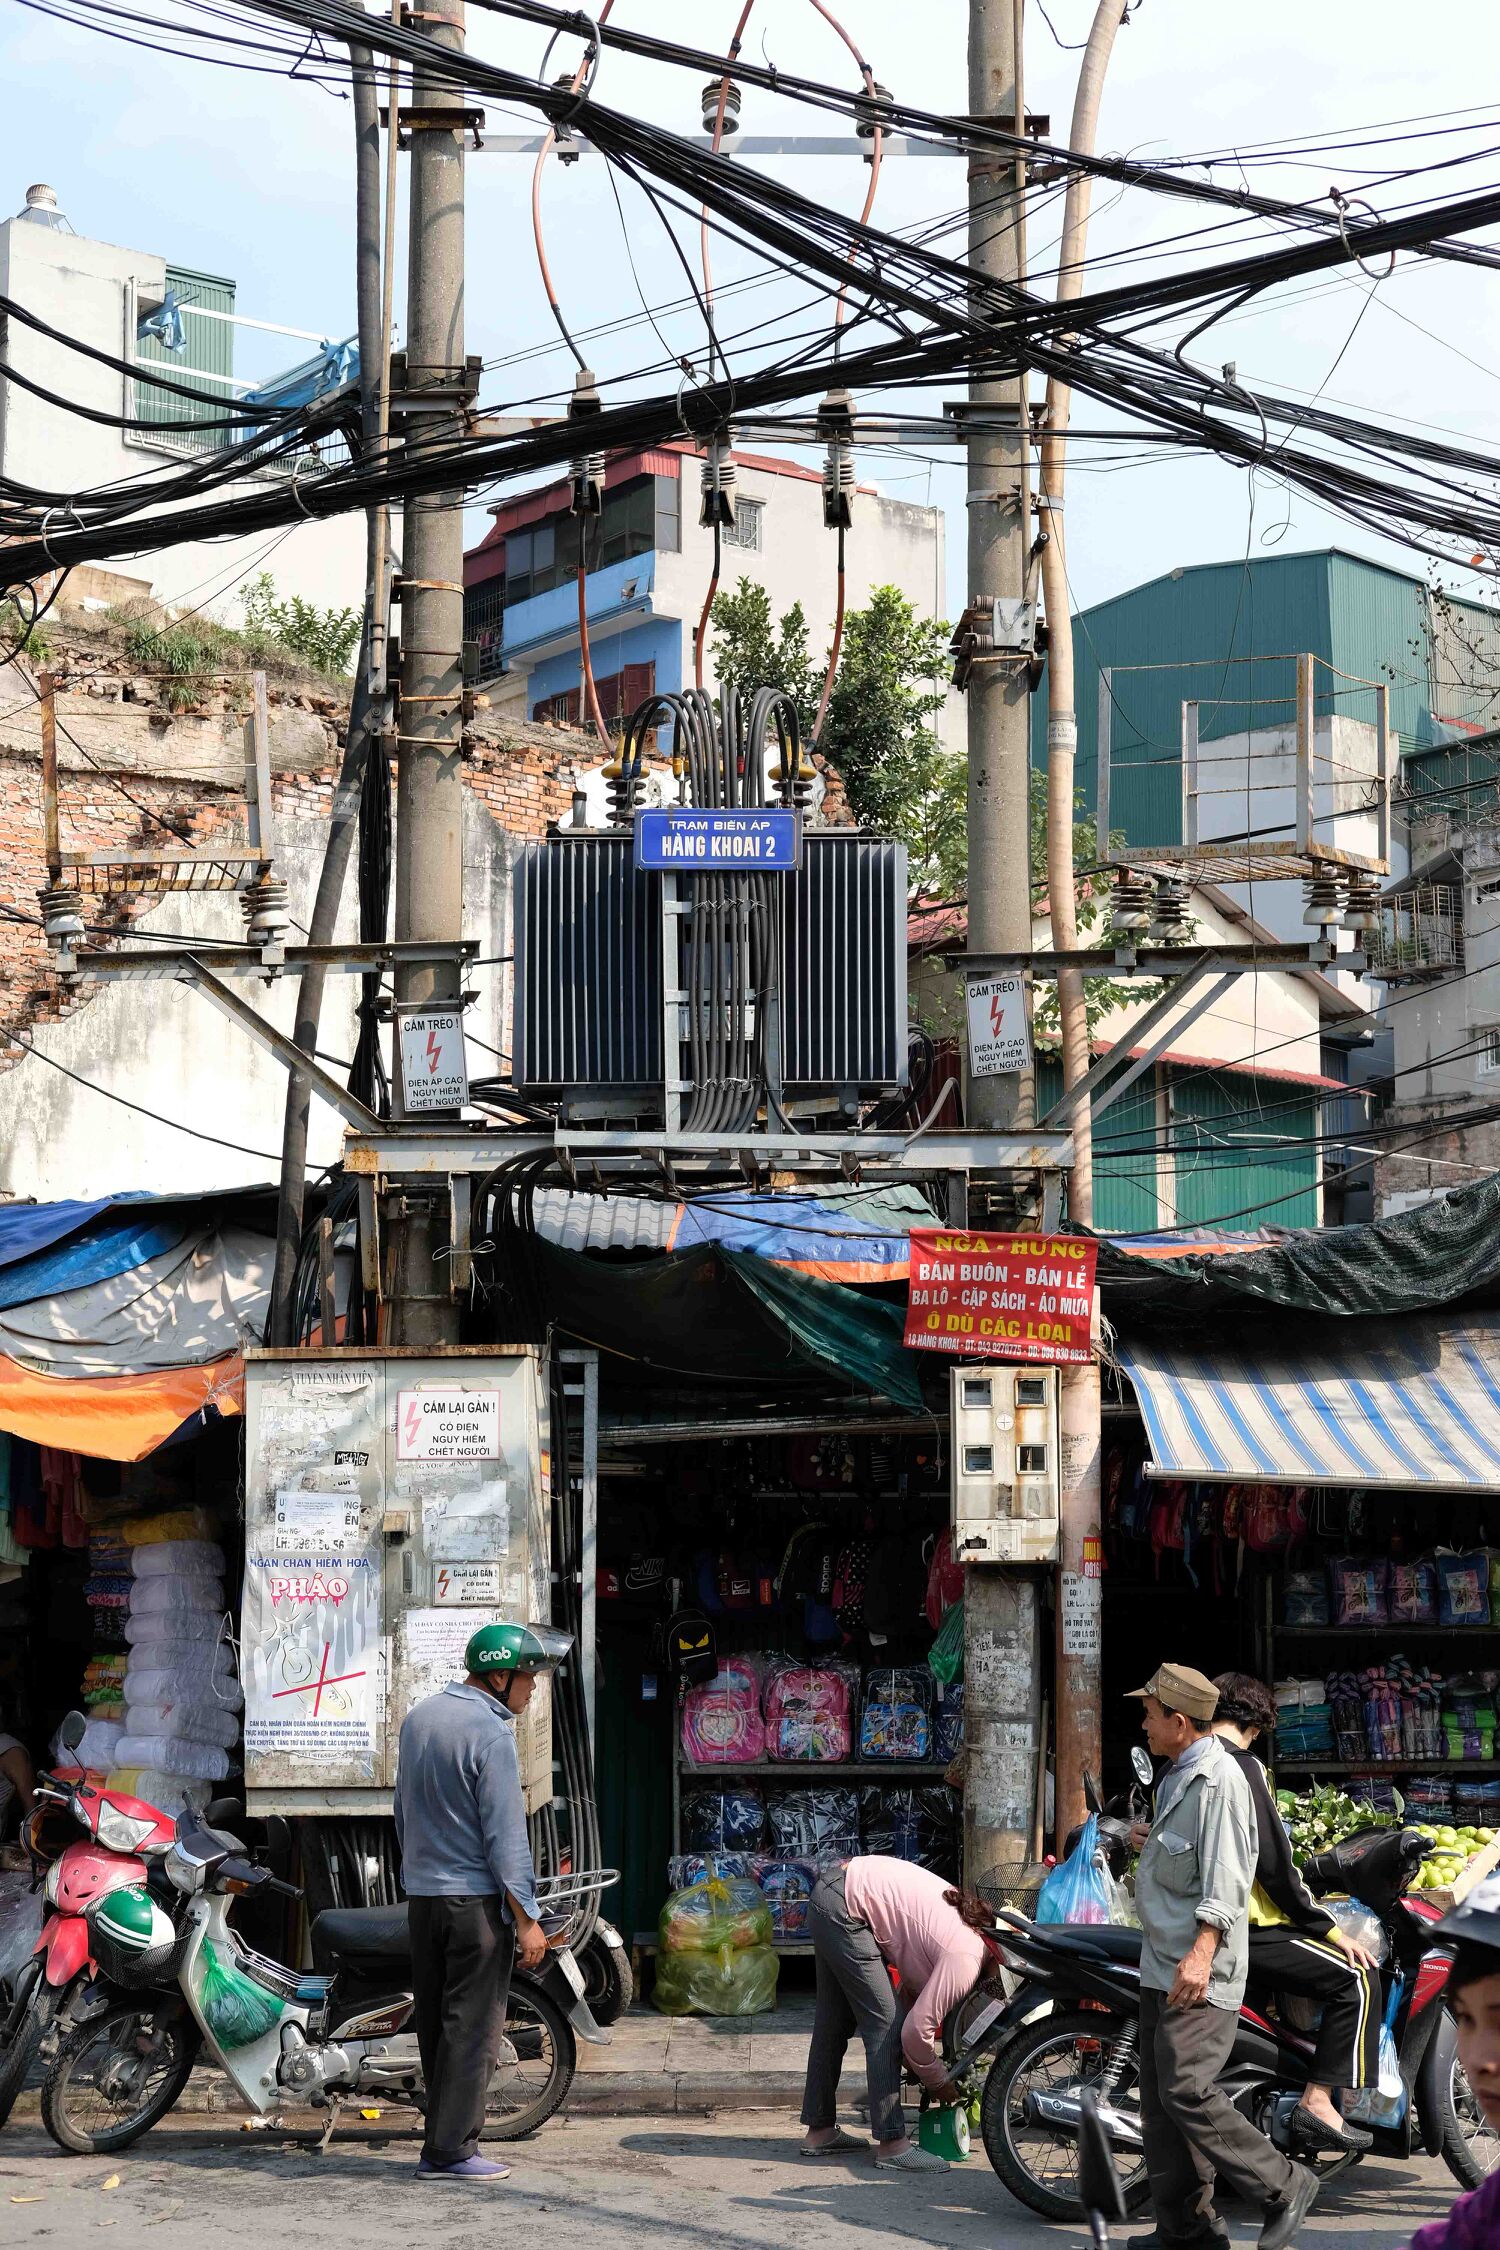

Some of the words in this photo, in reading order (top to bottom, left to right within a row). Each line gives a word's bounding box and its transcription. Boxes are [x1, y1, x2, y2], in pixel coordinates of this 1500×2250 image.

[669, 821, 708, 831] TRẠM
[714, 820, 746, 830] BIẾN
[750, 820, 770, 830] ÁP
[662, 832, 706, 856] HÀNG
[711, 836, 760, 857] KHOAI
[766, 836, 776, 857] 2
[991, 980, 1014, 994] TRÈO
[1008, 1038, 1024, 1047] CAO
[978, 1052, 1000, 1062] NGUY
[444, 1076, 463, 1084] CAO
[412, 1089, 437, 1097] NGUY
[935, 1236, 990, 1252] NGA
[919, 1260, 954, 1280] BÁN
[960, 1262, 1008, 1282] BUÔN
[1026, 1265, 1062, 1287] BÁN
[1066, 1265, 1086, 1289] LẺ
[912, 1290, 928, 1306] BA
[932, 1287, 948, 1305] LÔ
[961, 1287, 988, 1310] CẶP
[992, 1290, 1026, 1311] SÁCH
[1038, 1292, 1056, 1313] ÁO
[1060, 1297, 1089, 1316] MƯA
[927, 1311, 940, 1330] Ô
[946, 1312, 974, 1333] DÙ
[980, 1316, 1020, 1338] CÁC
[1027, 1322, 1072, 1345] LOẠI
[918, 1332, 938, 1348] HÀNG
[938, 1336, 960, 1350] KHOAI
[326, 1370, 350, 1384] NHÂN
[352, 1370, 373, 1384] VIÊN
[448, 1402, 464, 1416] LẠI
[440, 1422, 454, 1431] CÓ
[456, 1423, 478, 1432] ĐIỆN
[457, 1446, 490, 1456] NGƯỜI
[820, 1556, 832, 1594] adidas
[270, 1573, 348, 1598] PHÁO
[478, 1646, 512, 1662] Grab
[1424, 1964, 1448, 1972] HONDA
